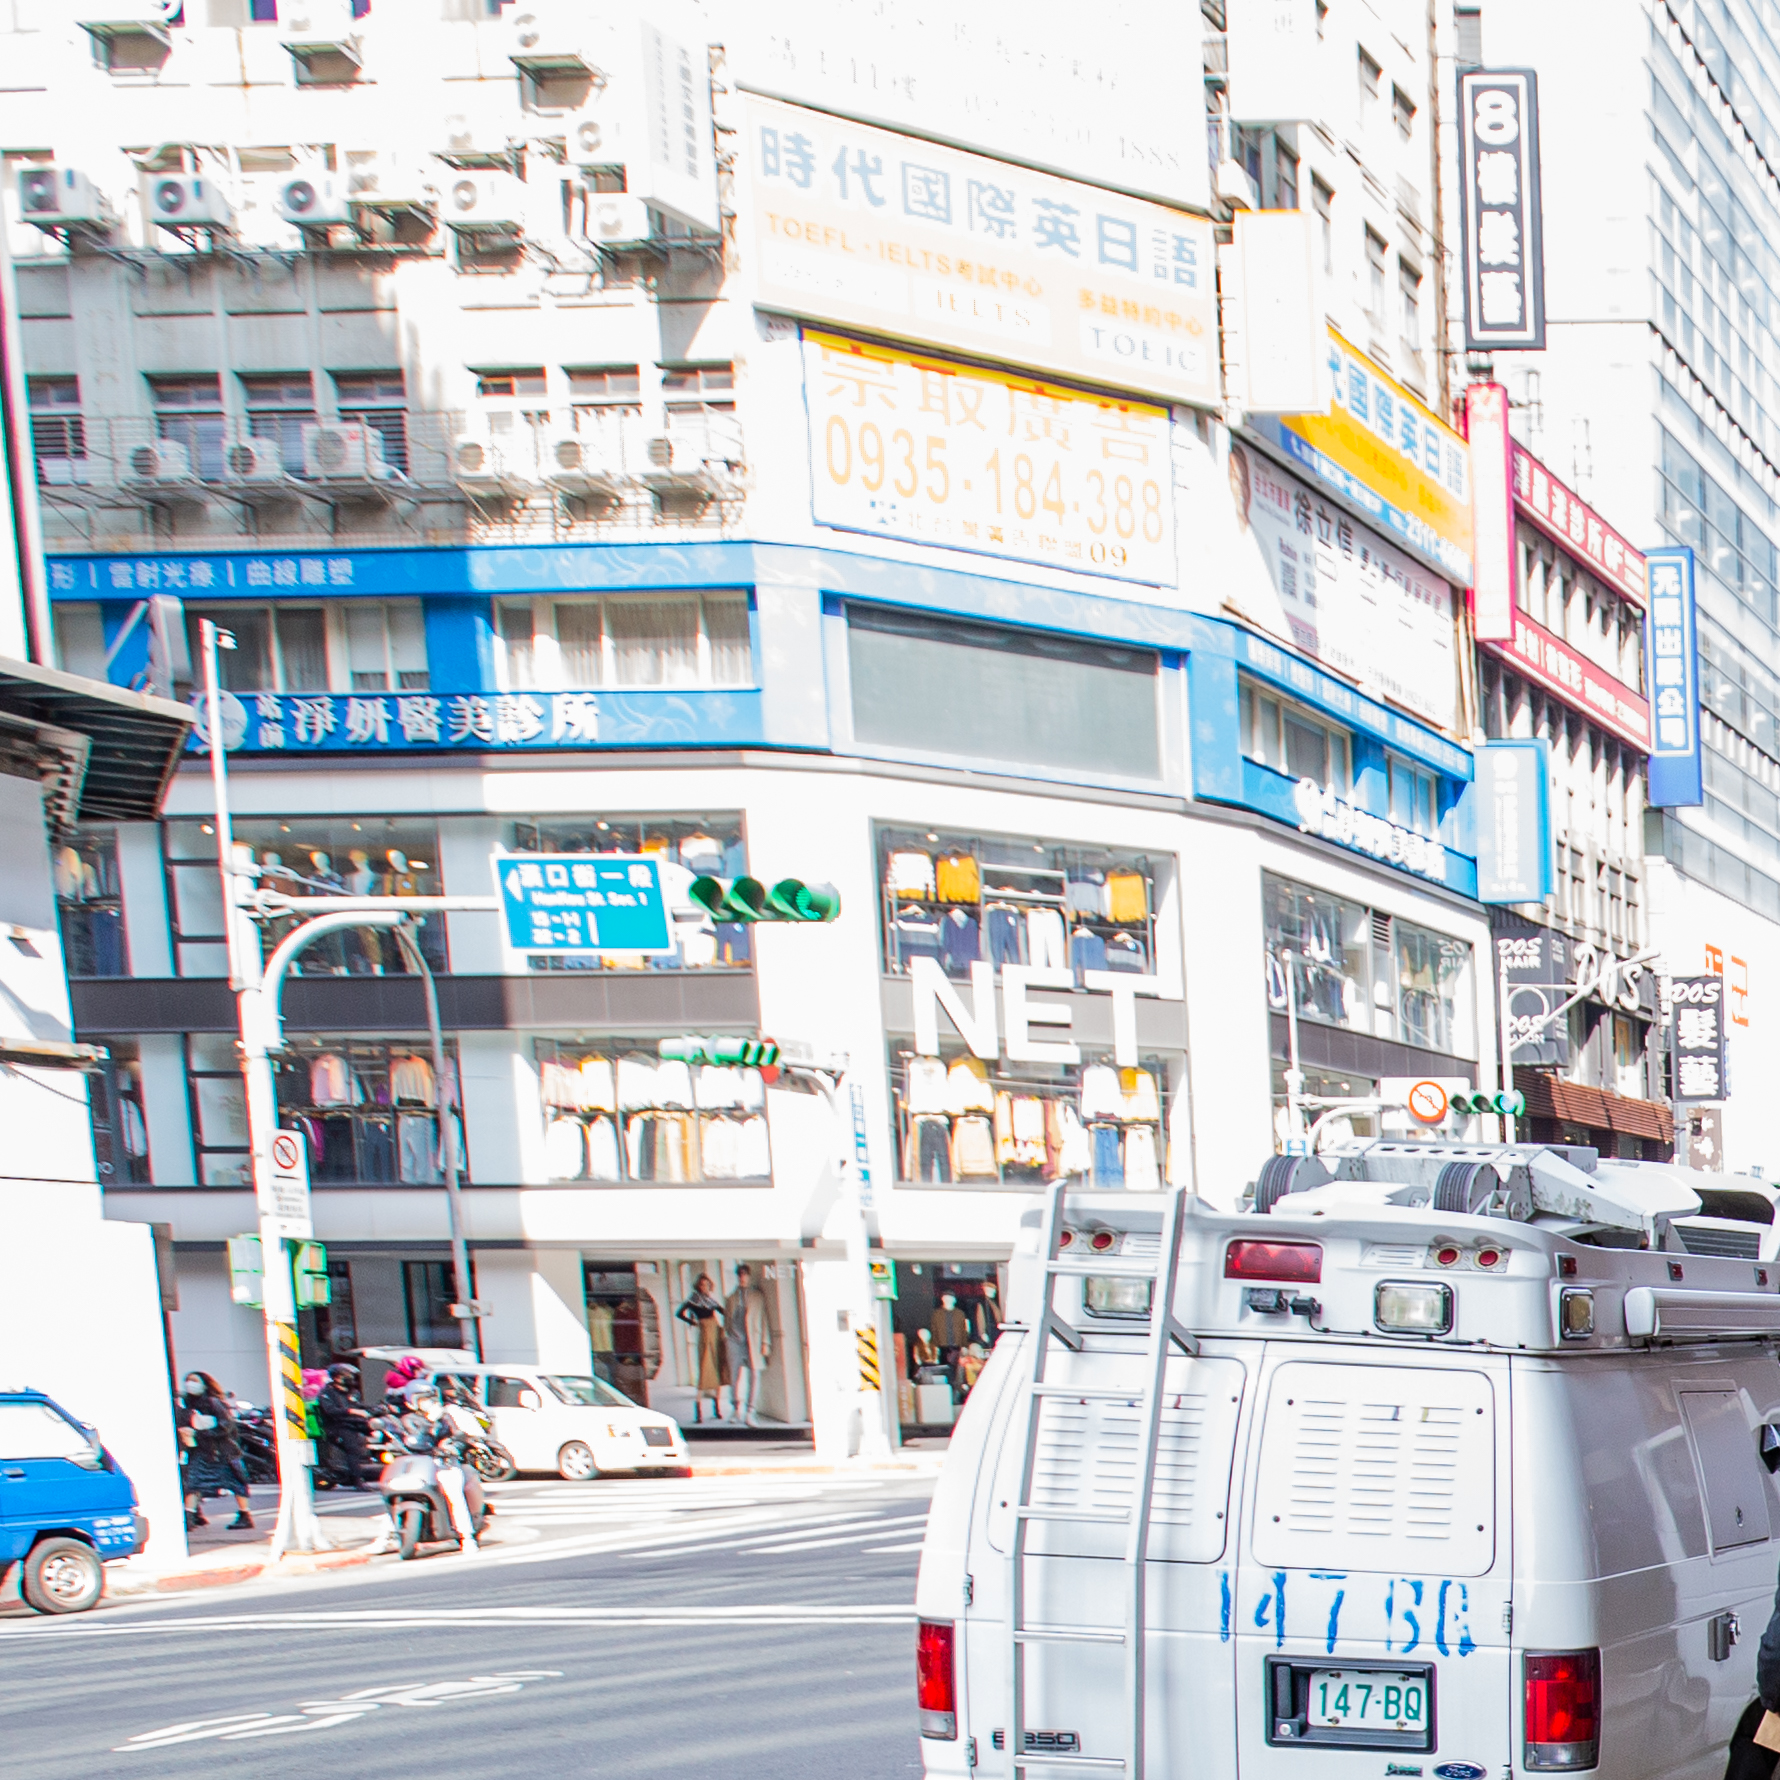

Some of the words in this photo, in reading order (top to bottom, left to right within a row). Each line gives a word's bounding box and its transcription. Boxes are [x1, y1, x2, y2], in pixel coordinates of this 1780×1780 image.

[759, 125, 1199, 289] 時代國際英日語
[288, 690, 601, 746] 淨妍醫美診所
[908, 953, 1163, 1069] NET
[1672, 981, 1722, 1004] DOS
[1319, 1682, 1424, 1722] 147-BQ
